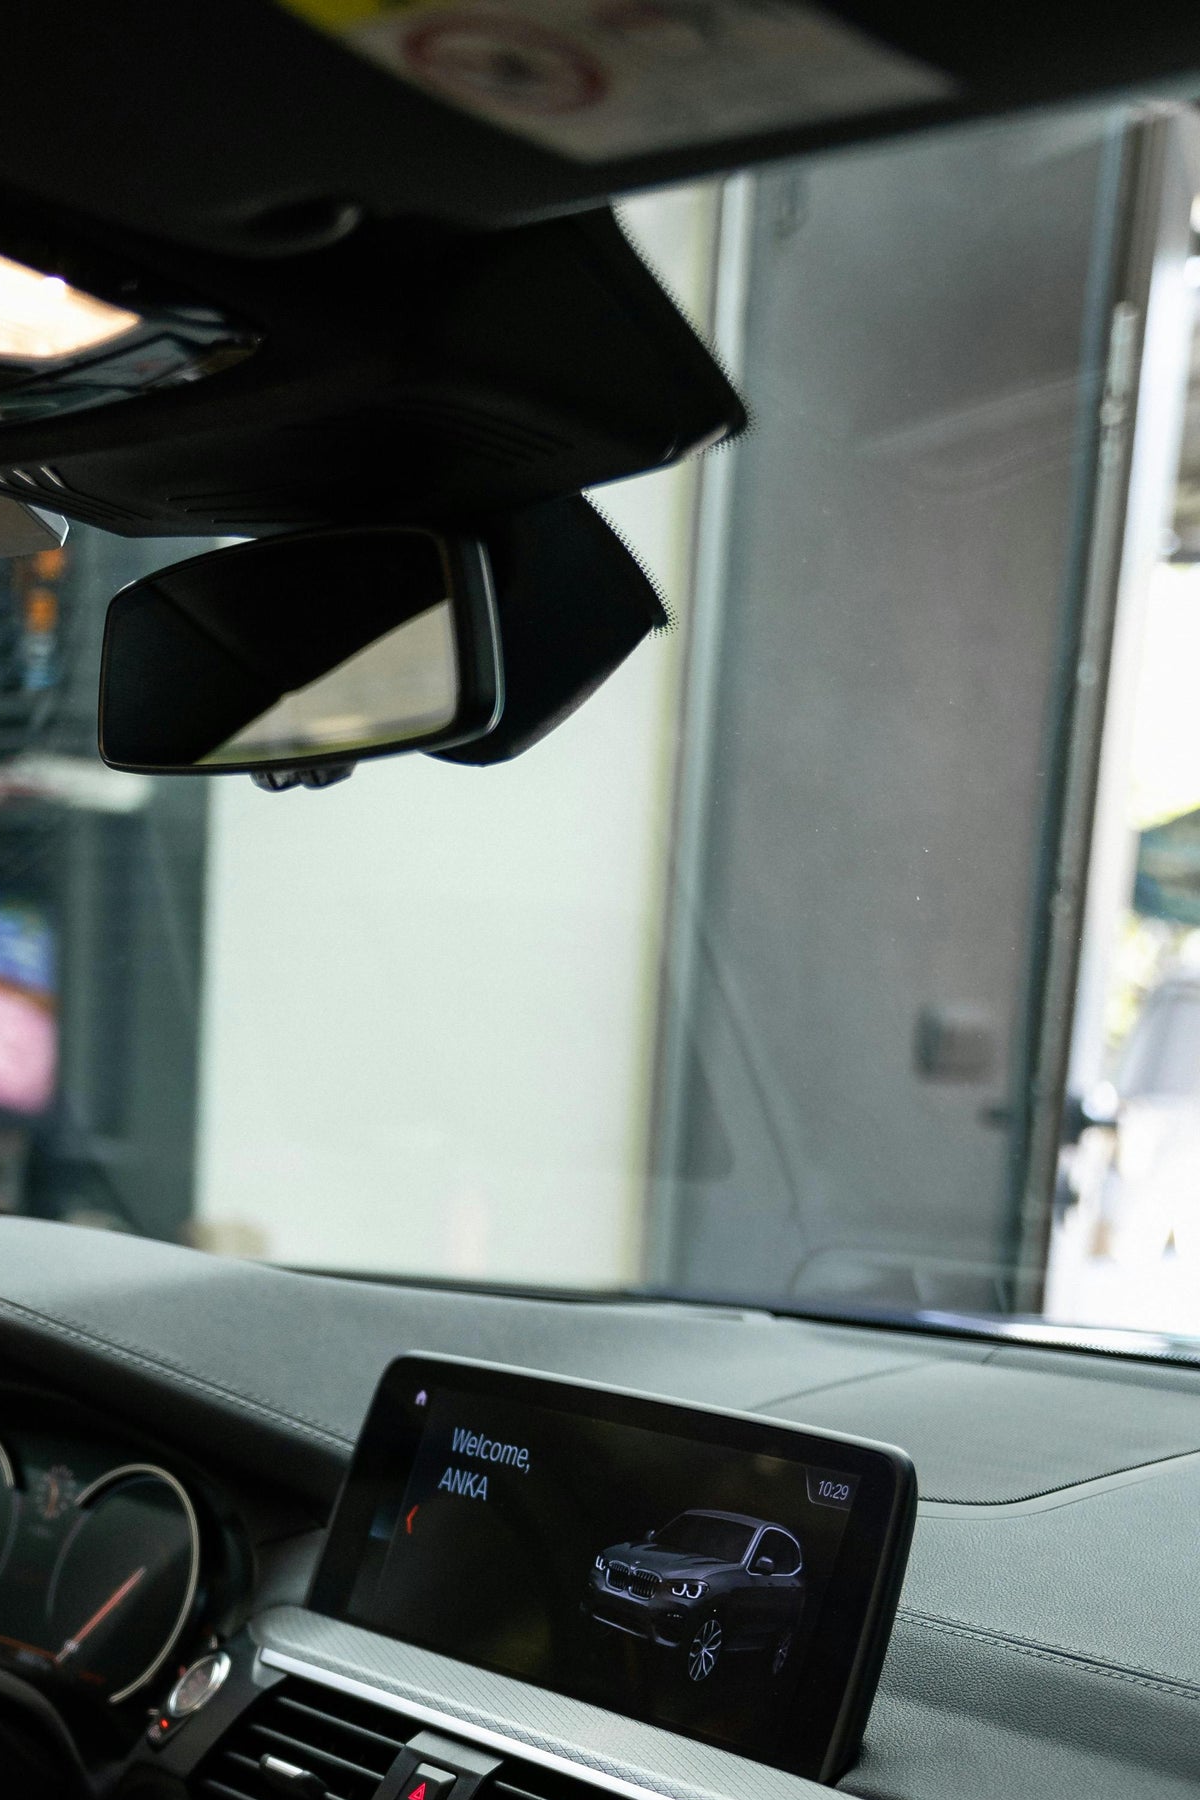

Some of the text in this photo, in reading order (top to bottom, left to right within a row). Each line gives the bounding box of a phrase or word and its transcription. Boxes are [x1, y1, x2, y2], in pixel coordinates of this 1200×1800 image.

[452, 1427, 530, 1474] Welcome,
[438, 1467, 488, 1501] ANKA
[818, 1480, 849, 1500] 10:29
